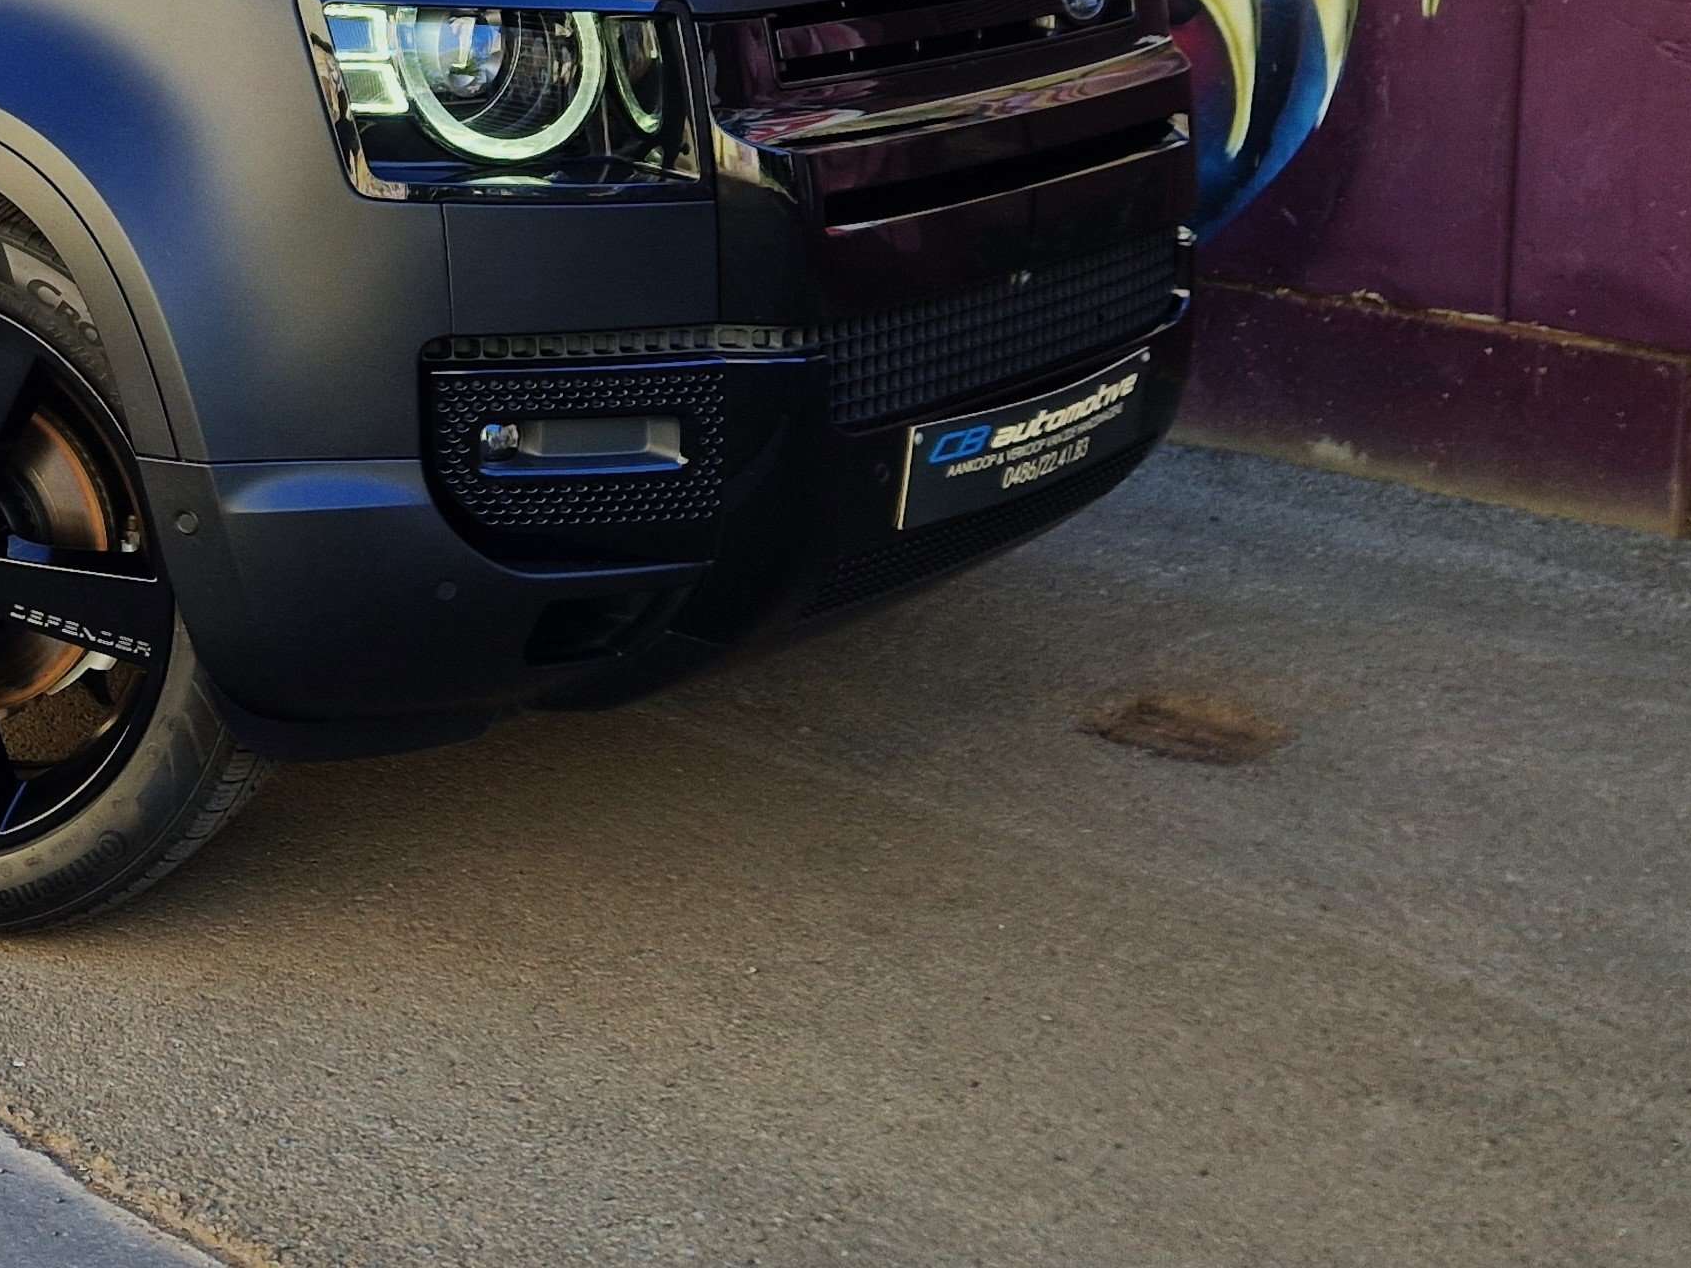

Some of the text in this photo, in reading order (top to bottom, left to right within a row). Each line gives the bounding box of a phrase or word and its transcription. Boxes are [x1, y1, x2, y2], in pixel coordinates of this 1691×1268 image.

[928, 424, 993, 464] CB
[989, 372, 1139, 449] automotive
[9, 603, 152, 658] DEFENDER
